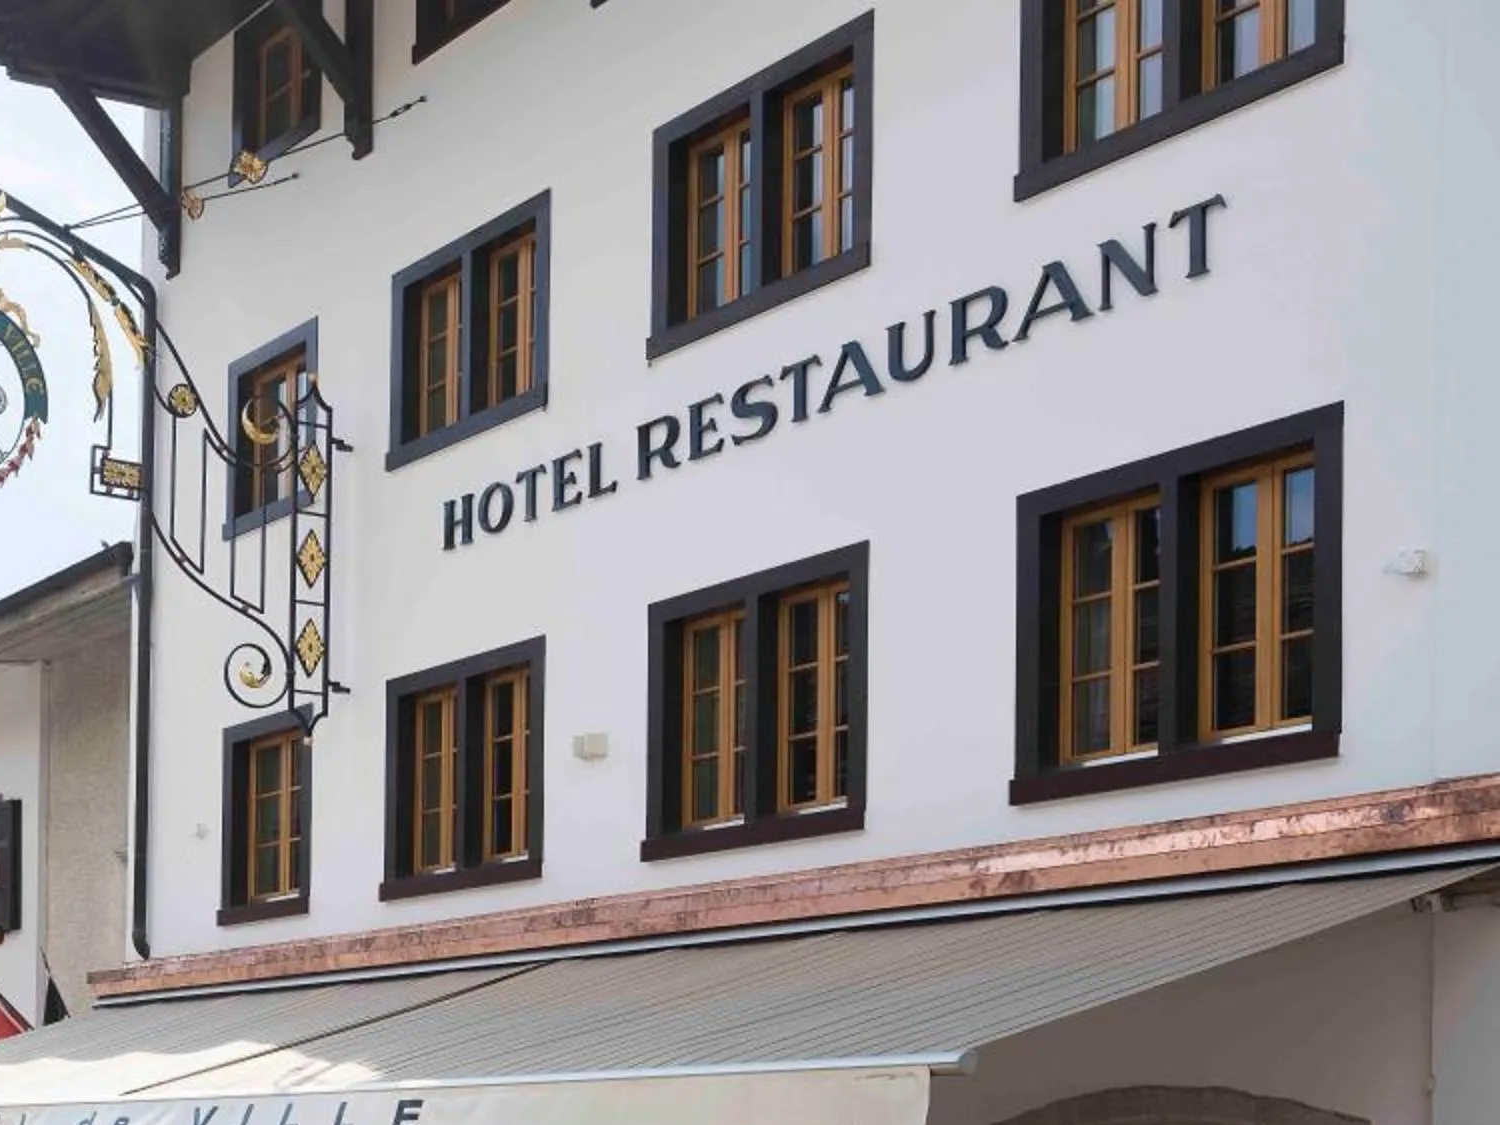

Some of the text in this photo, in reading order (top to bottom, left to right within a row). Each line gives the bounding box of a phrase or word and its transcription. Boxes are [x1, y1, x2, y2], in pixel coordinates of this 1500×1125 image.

[3, 323, 44, 395] VILLE
[442, 194, 1227, 551] HOTEL RESTAURANT
